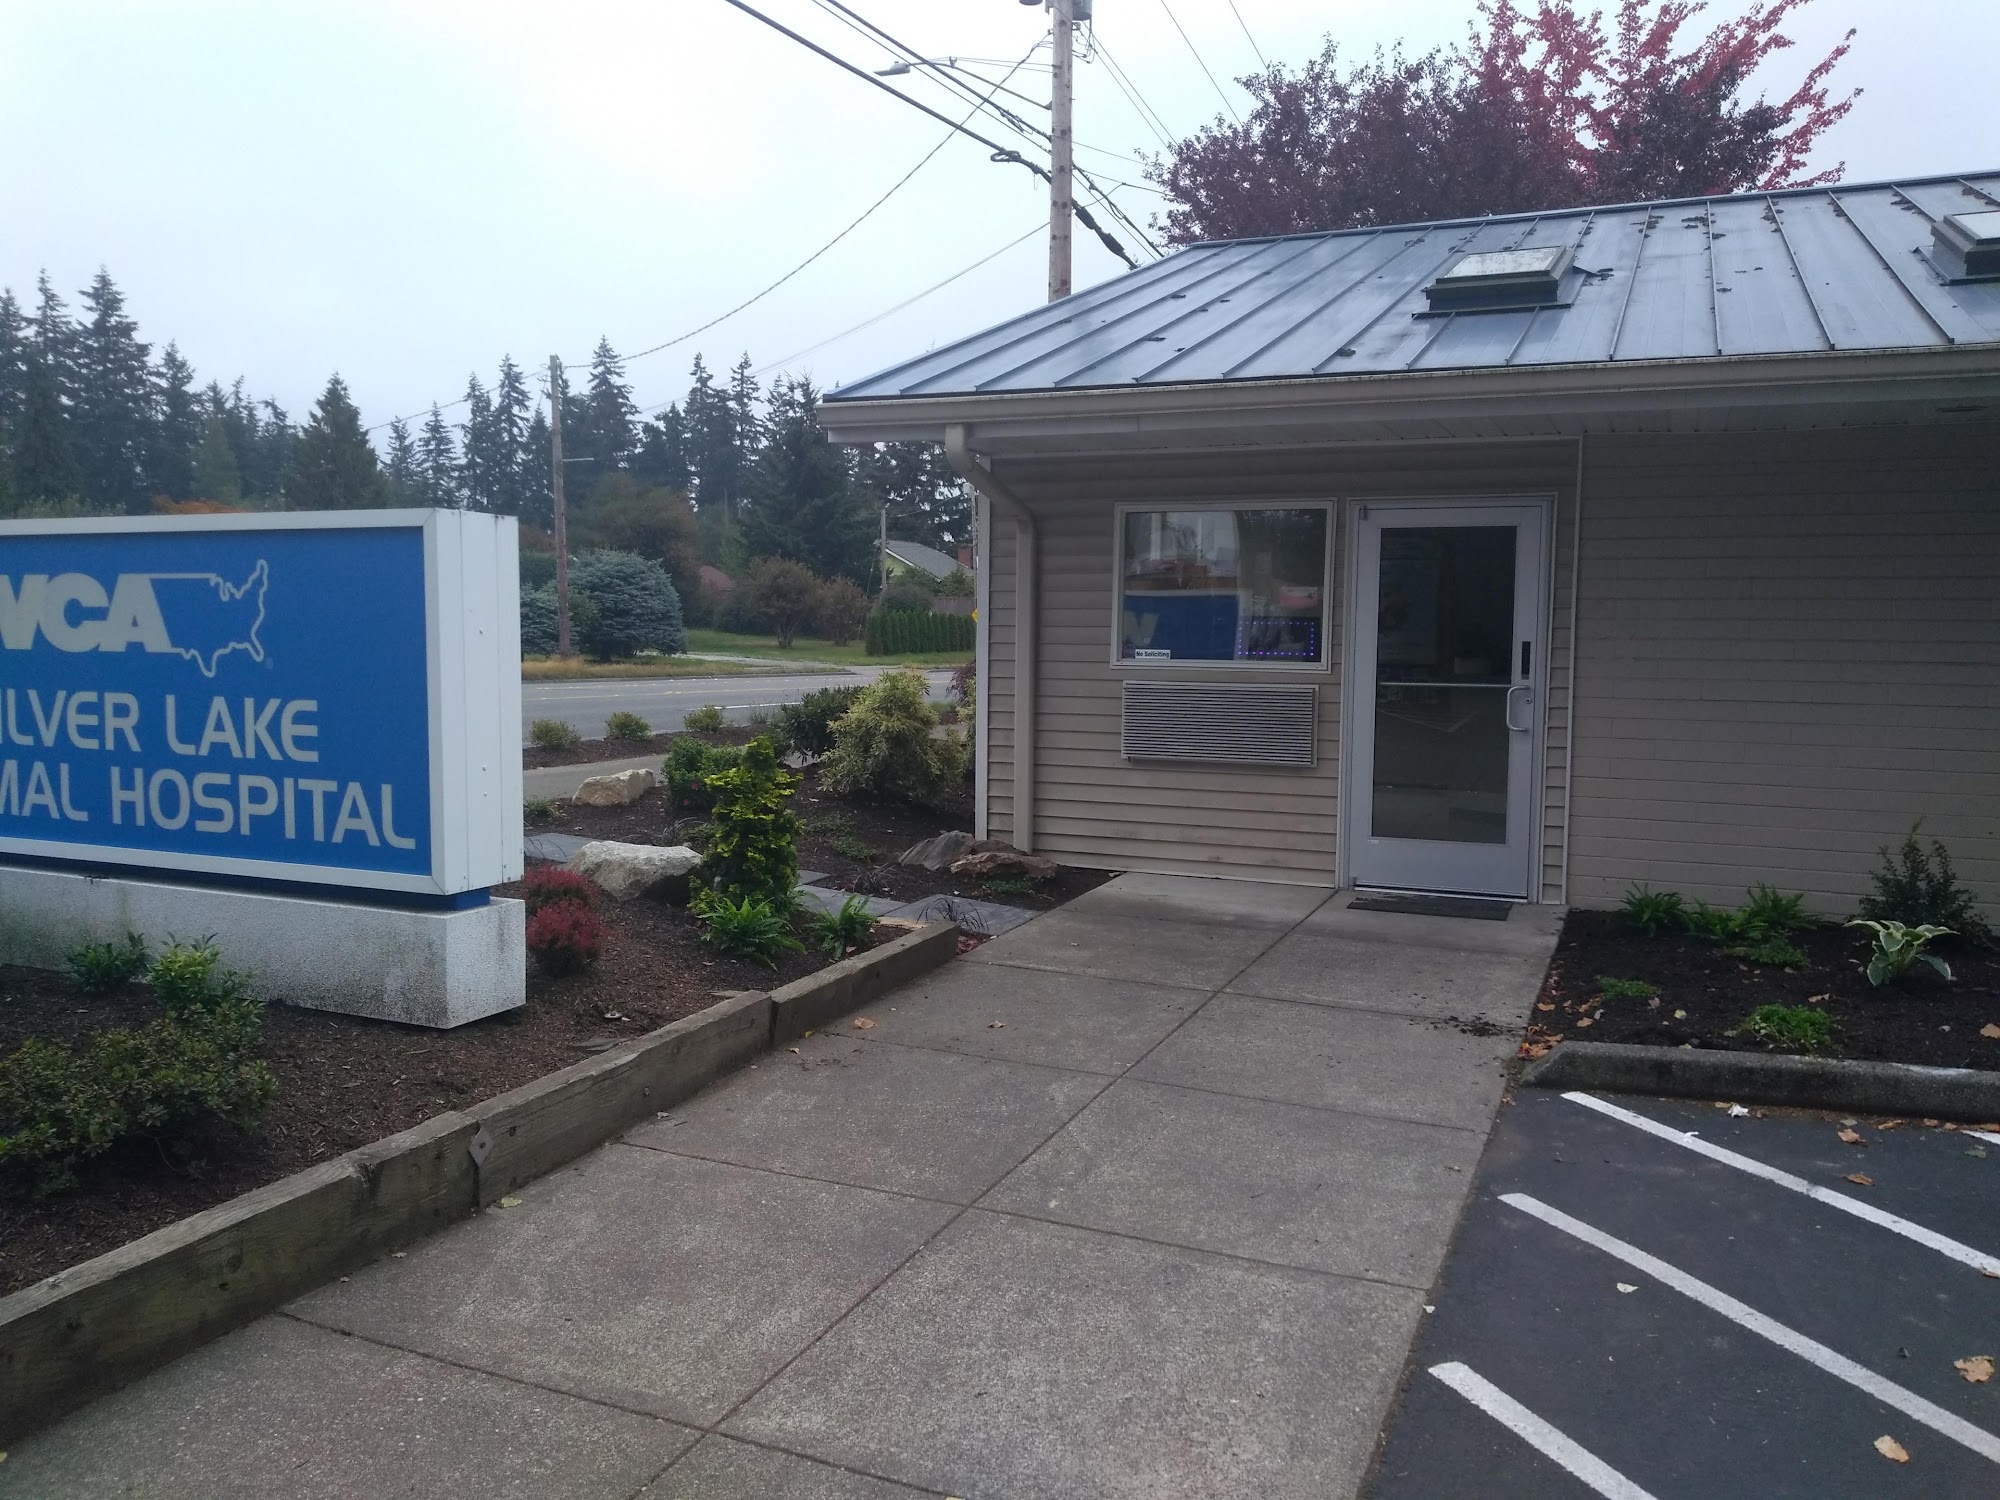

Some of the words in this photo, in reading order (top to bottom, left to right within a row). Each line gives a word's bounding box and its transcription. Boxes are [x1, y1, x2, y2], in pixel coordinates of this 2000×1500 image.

[0, 687, 141, 752] LVER
[165, 694, 319, 763] LAKE
[110, 766, 416, 850] HOSPITAL
